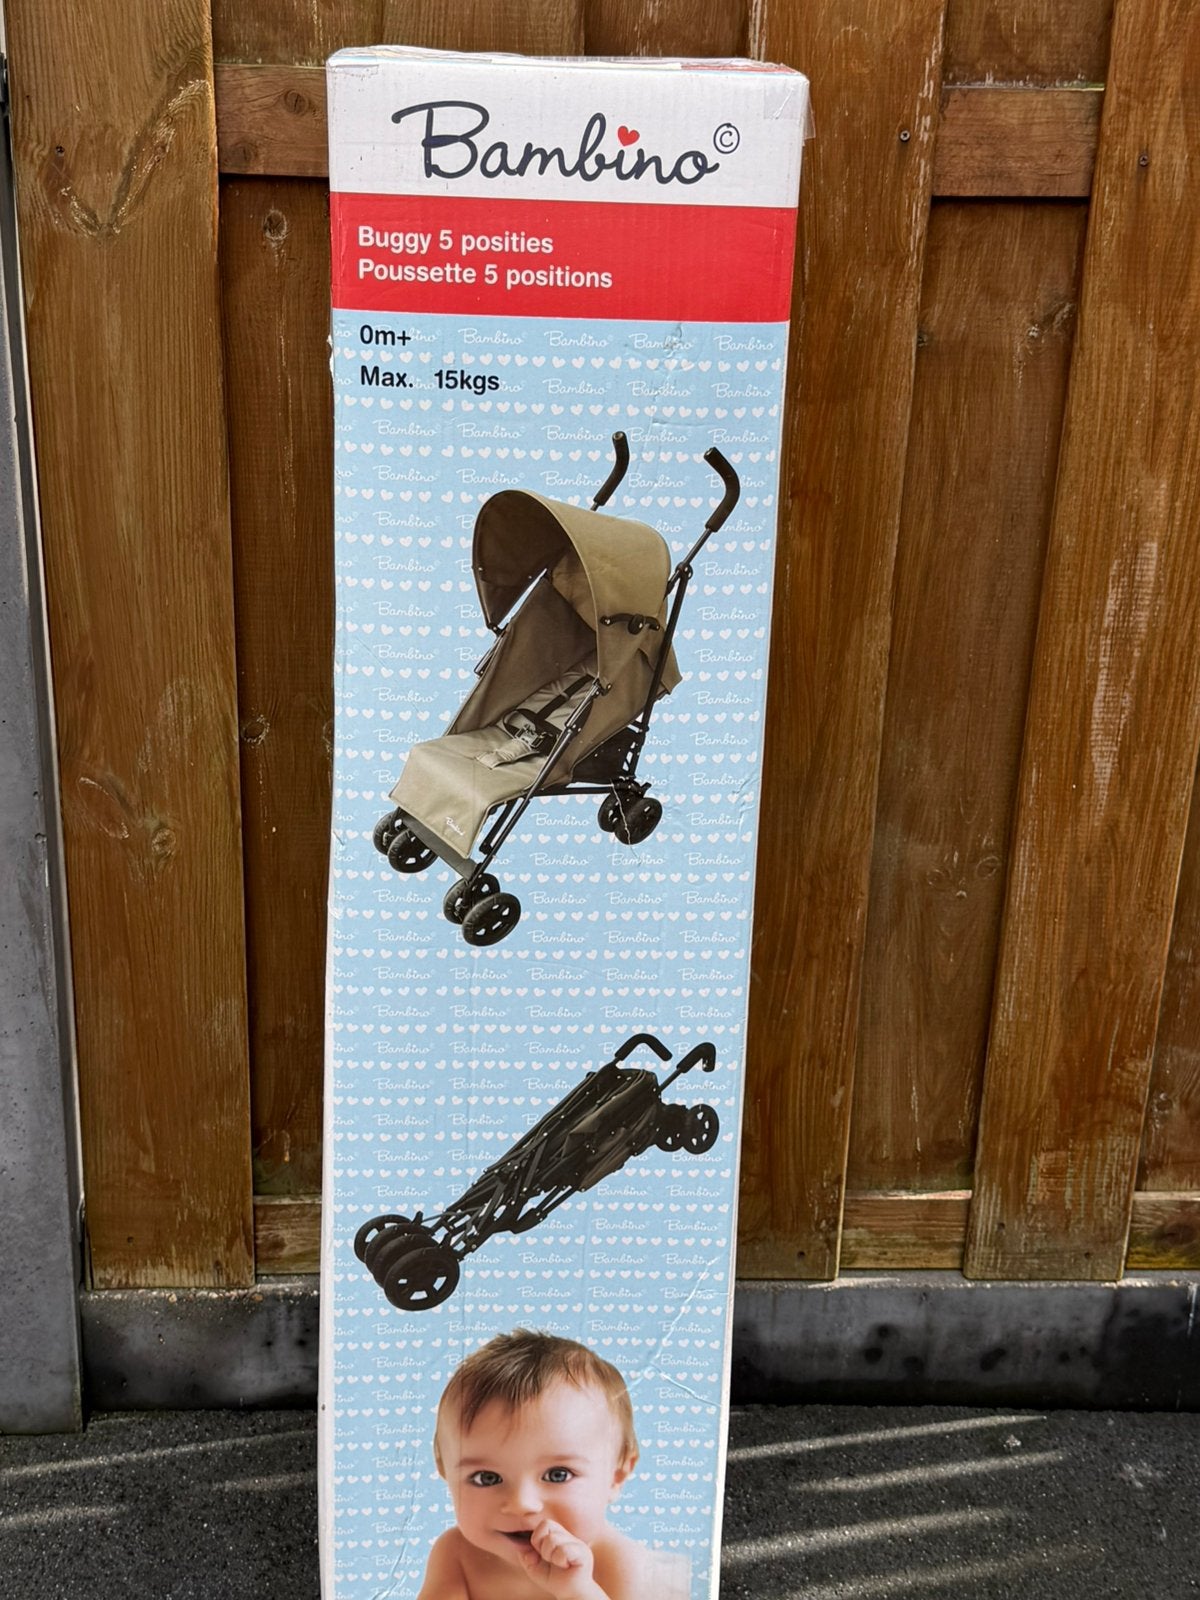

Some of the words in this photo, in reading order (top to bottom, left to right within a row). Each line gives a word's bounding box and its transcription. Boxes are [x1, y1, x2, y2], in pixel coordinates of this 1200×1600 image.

[391, 100, 720, 186] Bambino
[358, 226, 432, 255] Buggy
[439, 230, 453, 250] 5
[461, 231, 554, 256] posities
[358, 258, 477, 284] Poussette
[484, 263, 498, 285] 5
[506, 265, 613, 290] positions
[360, 324, 412, 346] 0m+
[458, 328, 523, 344] Bambino
[544, 331, 608, 347] Bambino
[714, 335, 774, 351] Bambino
[360, 365, 414, 388] Max.
[434, 369, 501, 395] 15kgs
[543, 378, 608, 395] Bambino
[711, 383, 771, 398] Bambino
[373, 420, 437, 436] Bambino
[457, 423, 521, 438] Bambino
[541, 425, 605, 442] Bambino
[625, 426, 689, 443] Bambino
[708, 428, 768, 443] Bambino
[373, 465, 436, 482] Bambino
[456, 469, 521, 484] Bambino
[540, 471, 603, 487] Bambino
[373, 511, 437, 528] Bambino
[655, 519, 683, 533] bino
[373, 556, 436, 572] Bambino
[700, 562, 760, 576] Bambino
[373, 601, 436, 617] Bambino
[697, 607, 759, 620] Bambino
[373, 644, 434, 660] Bambino
[695, 649, 754, 662] Bambino
[373, 687, 437, 702] Bambino
[693, 691, 752, 704] Bambino
[690, 732, 748, 745] Bambino
[688, 773, 747, 786] Bambino
[531, 814, 591, 827] Bambino
[530, 853, 592, 865] Bambino
[607, 852, 667, 866] Bambino
[684, 853, 742, 865] Bambino
[373, 889, 432, 903] Bambino
[528, 891, 586, 904] Bambino
[605, 891, 662, 904] Bambino
[682, 891, 738, 904] Bambino
[373, 929, 432, 942] Bambino
[528, 930, 585, 943] Bambino
[604, 931, 660, 943] Bambino
[680, 930, 736, 943] Bambino
[373, 967, 433, 979] Bambino
[450, 968, 508, 979] Bambino
[527, 968, 584, 980] Bambino
[602, 968, 658, 981] Bambino
[678, 968, 734, 980] Bambino
[373, 1005, 430, 1017] Bambino
[450, 1005, 506, 1017] Bambino
[525, 1005, 581, 1017] Bambino
[600, 1006, 660, 1018] Bambino
[675, 1006, 734, 1018] Bambino
[374, 1041, 430, 1053] Bambino
[449, 1041, 505, 1053] Bambino
[524, 1041, 584, 1053] Bambino
[373, 1078, 430, 1090] Bambino
[448, 1077, 504, 1089] Bambino
[522, 1077, 575, 1091] Bambin
[373, 1114, 429, 1125] Bambino
[448, 1113, 504, 1125] Bambino
[373, 1150, 430, 1162] Bambino
[373, 1185, 428, 1196] Bambino
[593, 1183, 648, 1195] Bambino
[666, 1185, 720, 1197] Bambino
[592, 1218, 649, 1230] Bambino
[664, 1220, 717, 1231] Bambino
[519, 1252, 572, 1263] Bambino
[590, 1253, 645, 1264] Bambino
[517, 1286, 571, 1297] Bambino
[589, 1286, 643, 1298] Bambino
[372, 1323, 426, 1335] Bambino
[444, 1321, 498, 1332] Bambino
[588, 1320, 640, 1331] Bambino
[373, 1356, 425, 1368] Bambino
[657, 1356, 711, 1367] Bambino
[372, 1389, 425, 1401] Bambino
[373, 1424, 425, 1435] Bambino
[654, 1421, 705, 1432] Bambino
[653, 1455, 707, 1466] Bambino
[651, 1488, 702, 1499] Bambino
[648, 1519, 703, 1533] Bambino
